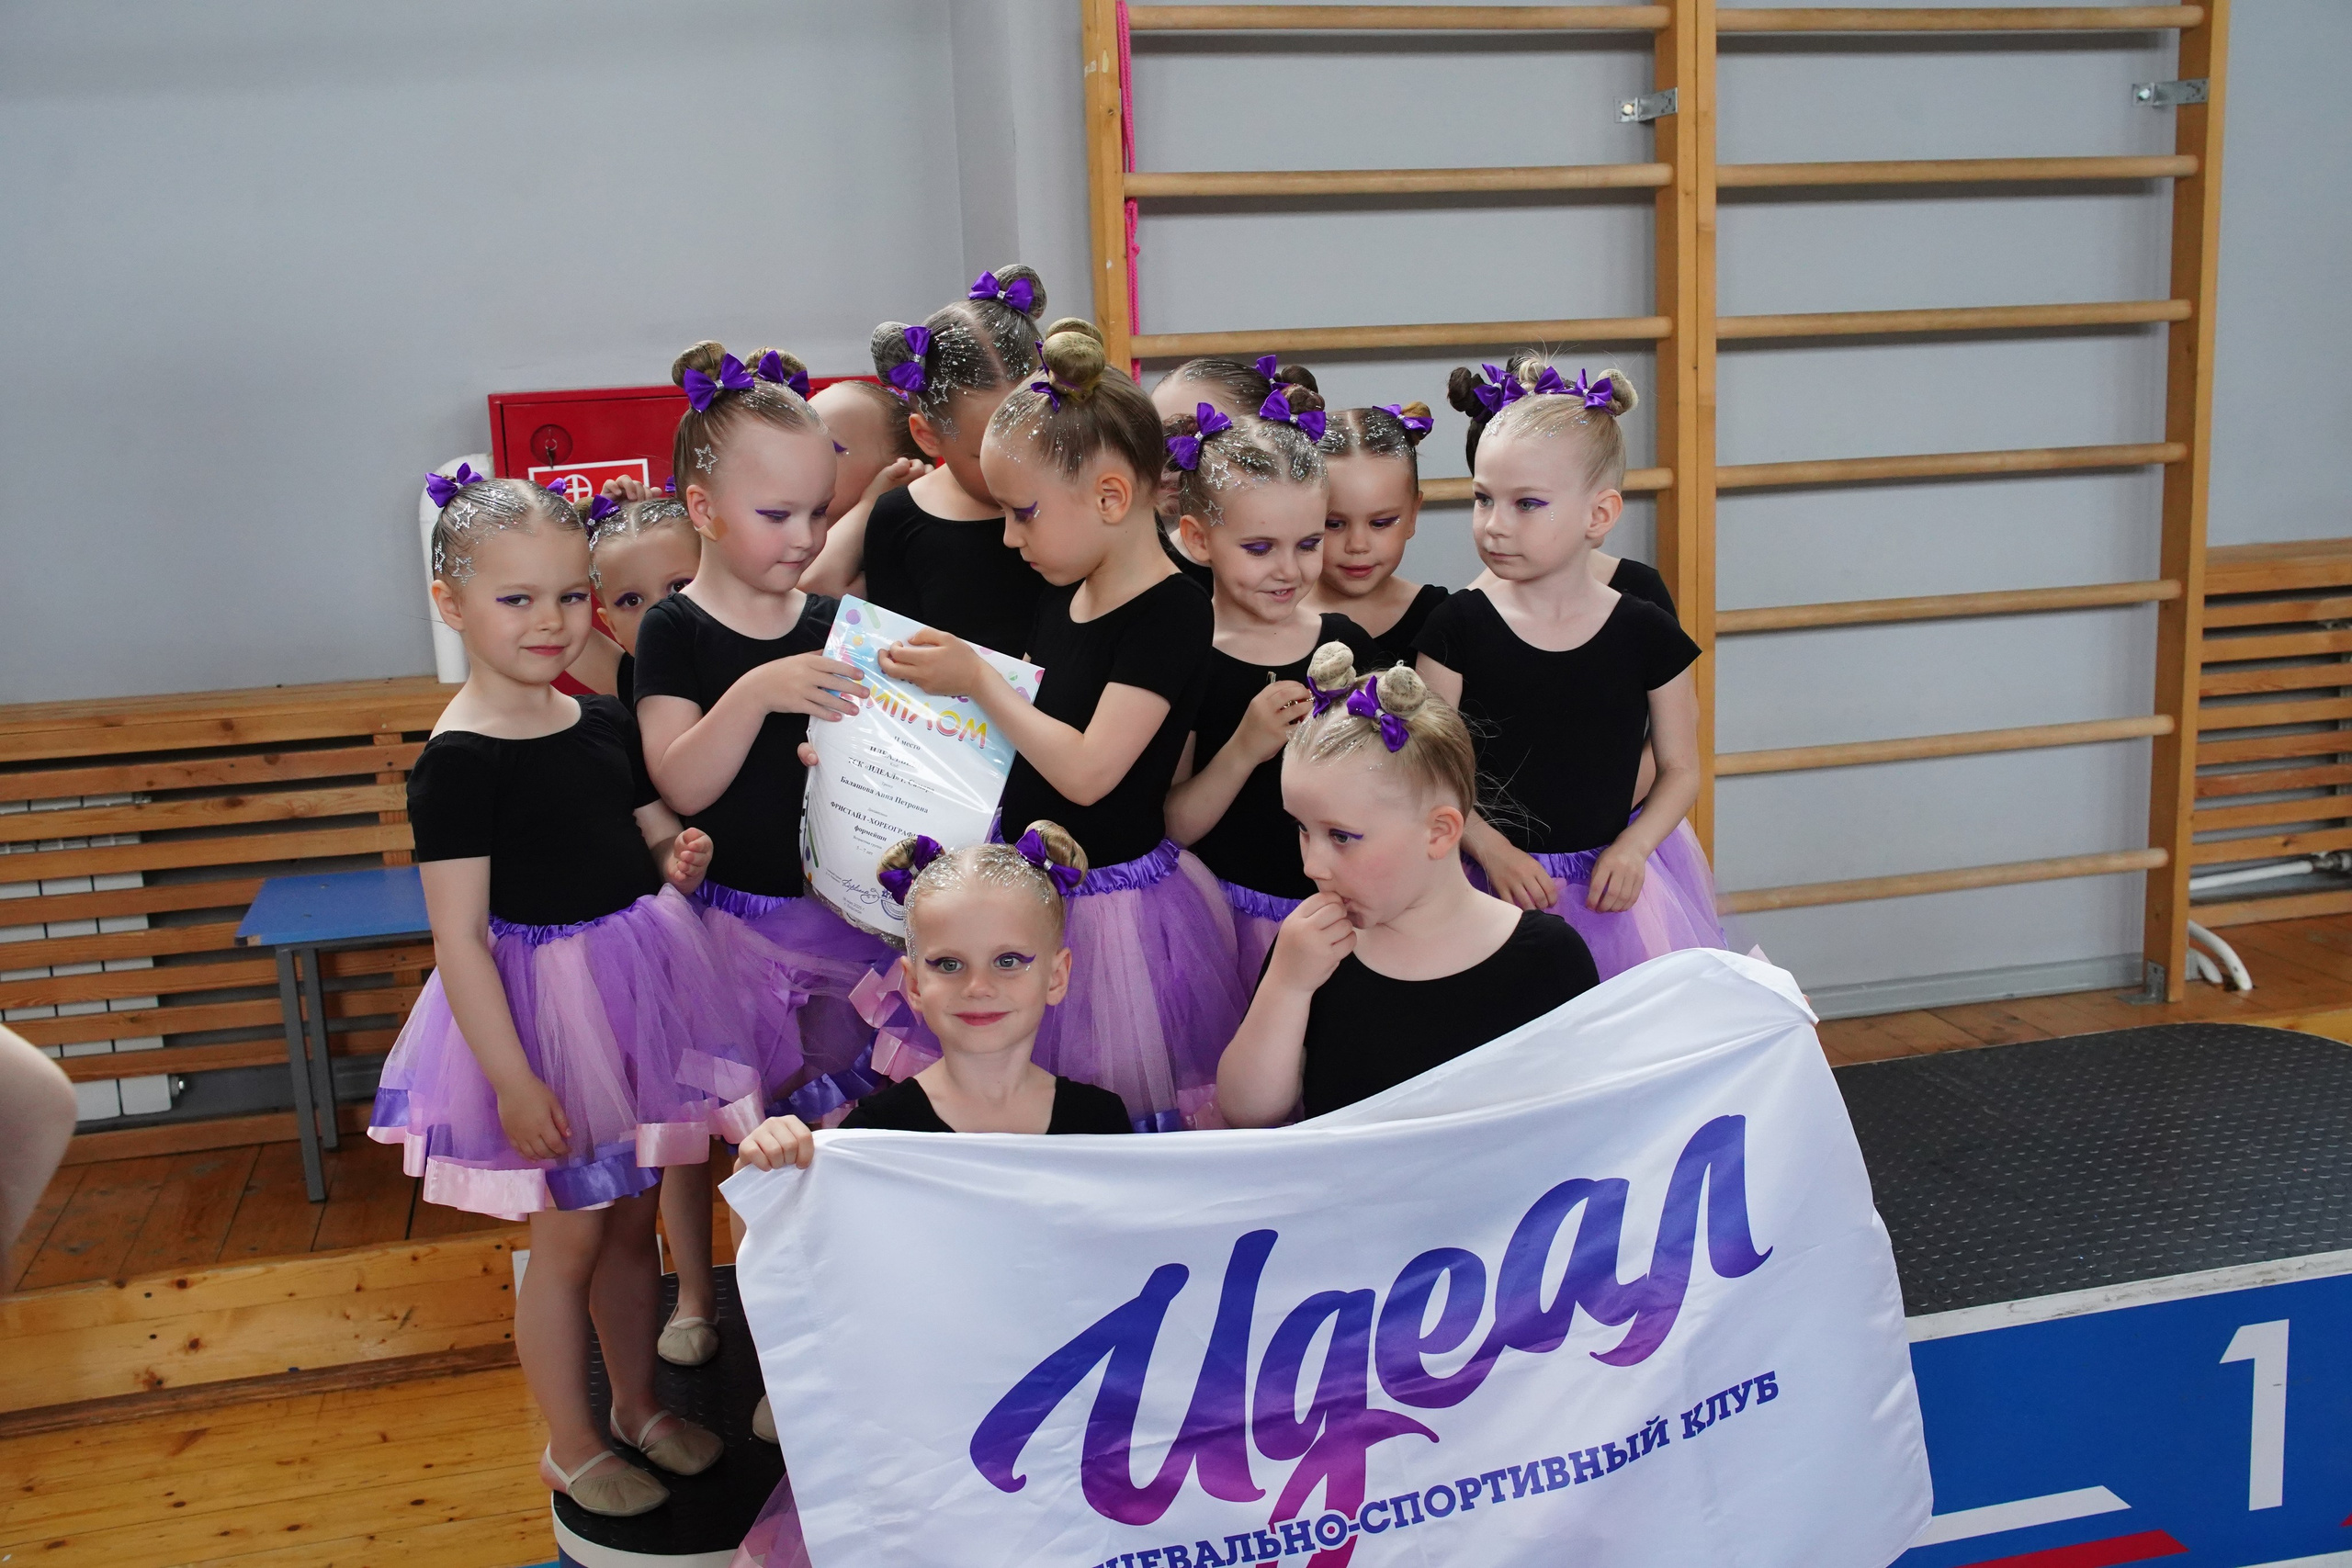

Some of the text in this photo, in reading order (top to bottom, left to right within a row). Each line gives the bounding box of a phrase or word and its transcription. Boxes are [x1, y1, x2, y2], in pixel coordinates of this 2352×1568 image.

[840, 775, 875, 795] Балашова
[875, 791, 894, 801] Анна
[895, 796, 929, 813] Петровна
[901, 739, 922, 750] место
[830, 801, 867, 822] ФРИСТАЙЛ
[866, 818, 918, 838] -ХОРЕОГРАФ
[969, 1113, 1774, 1568] Идеал
[1092, 1370, 1780, 1568] ЕВАЛЬНО-СПОРТИВНЫЙ КЛУБ
[2219, 1318, 2290, 1511] 1
